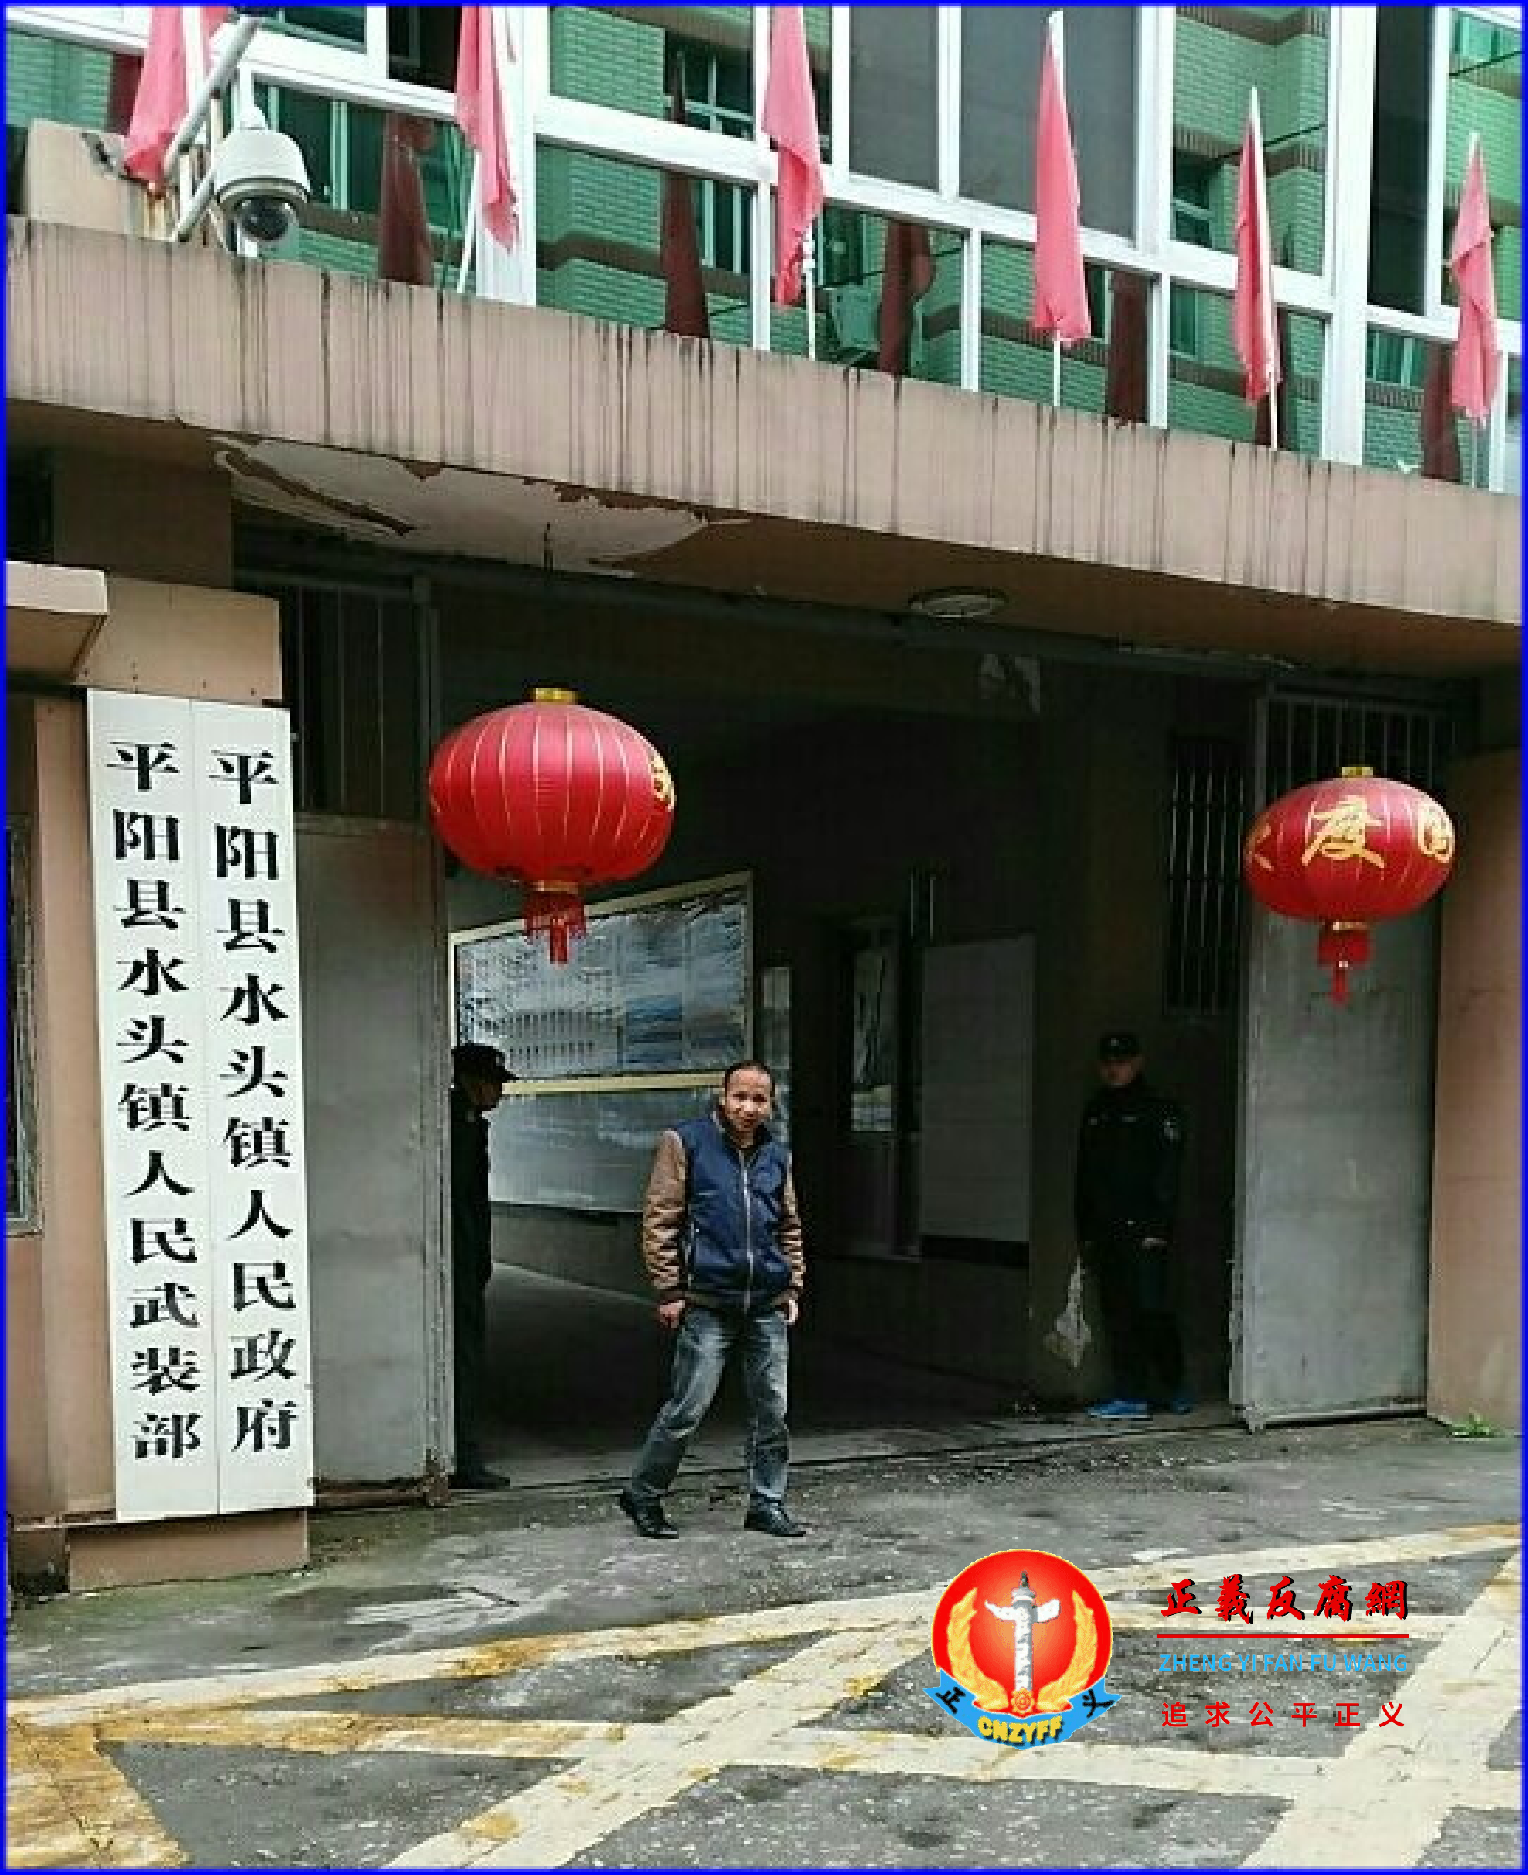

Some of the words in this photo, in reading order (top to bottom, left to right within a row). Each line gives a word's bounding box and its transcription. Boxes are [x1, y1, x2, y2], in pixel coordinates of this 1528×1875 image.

[106, 740, 202, 1460] 平阳县水头镇人民武装部
[208, 748, 299, 1453] 平阳县水头镇人民政府
